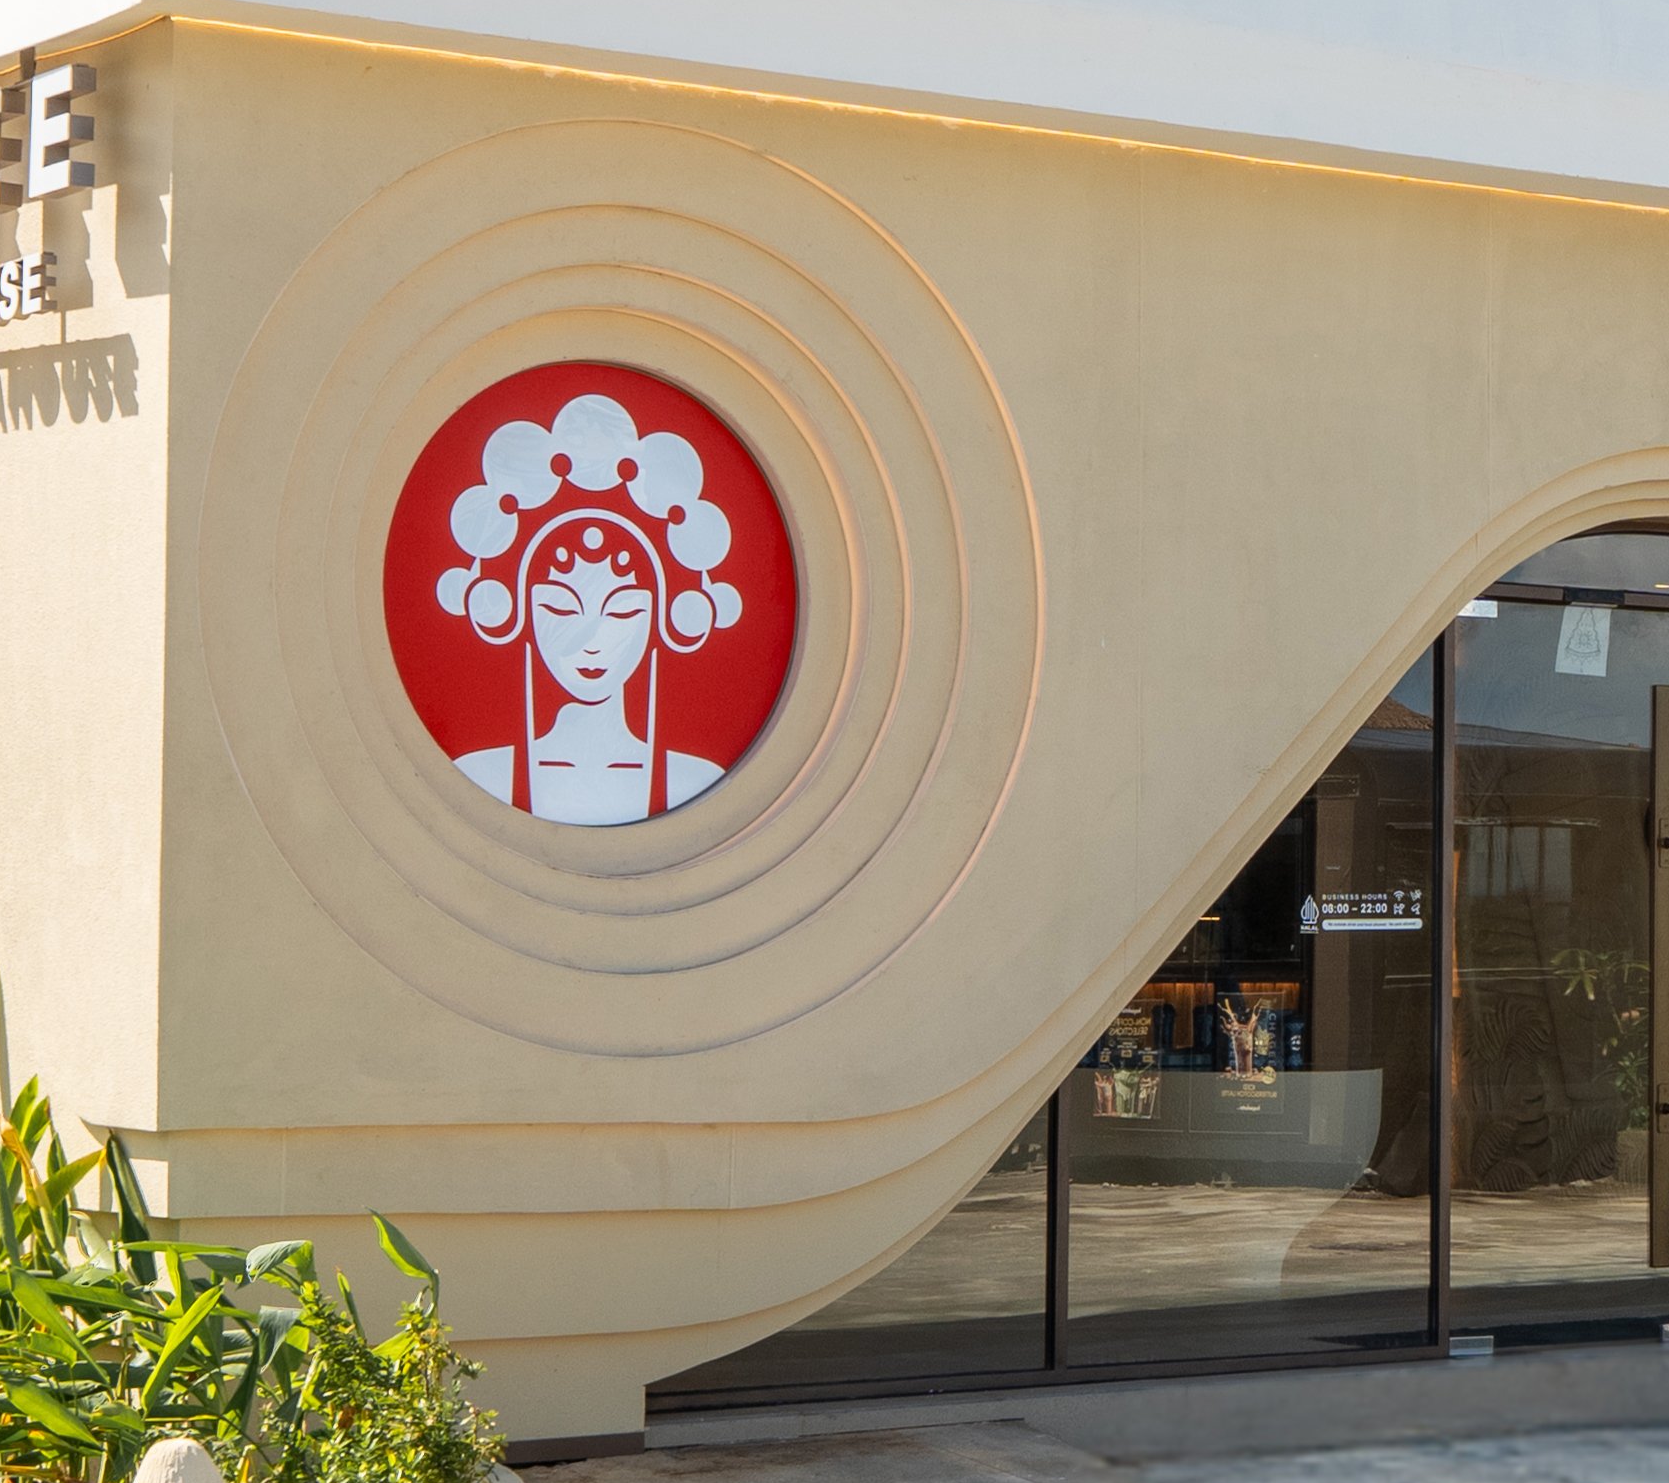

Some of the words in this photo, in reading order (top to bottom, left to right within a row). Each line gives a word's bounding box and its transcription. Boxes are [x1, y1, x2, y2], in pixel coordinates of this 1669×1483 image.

[1321, 893, 1360, 901] BUSINESS
[1361, 893, 1388, 901] HOURS
[1360, 902, 1388, 914] 22:00
